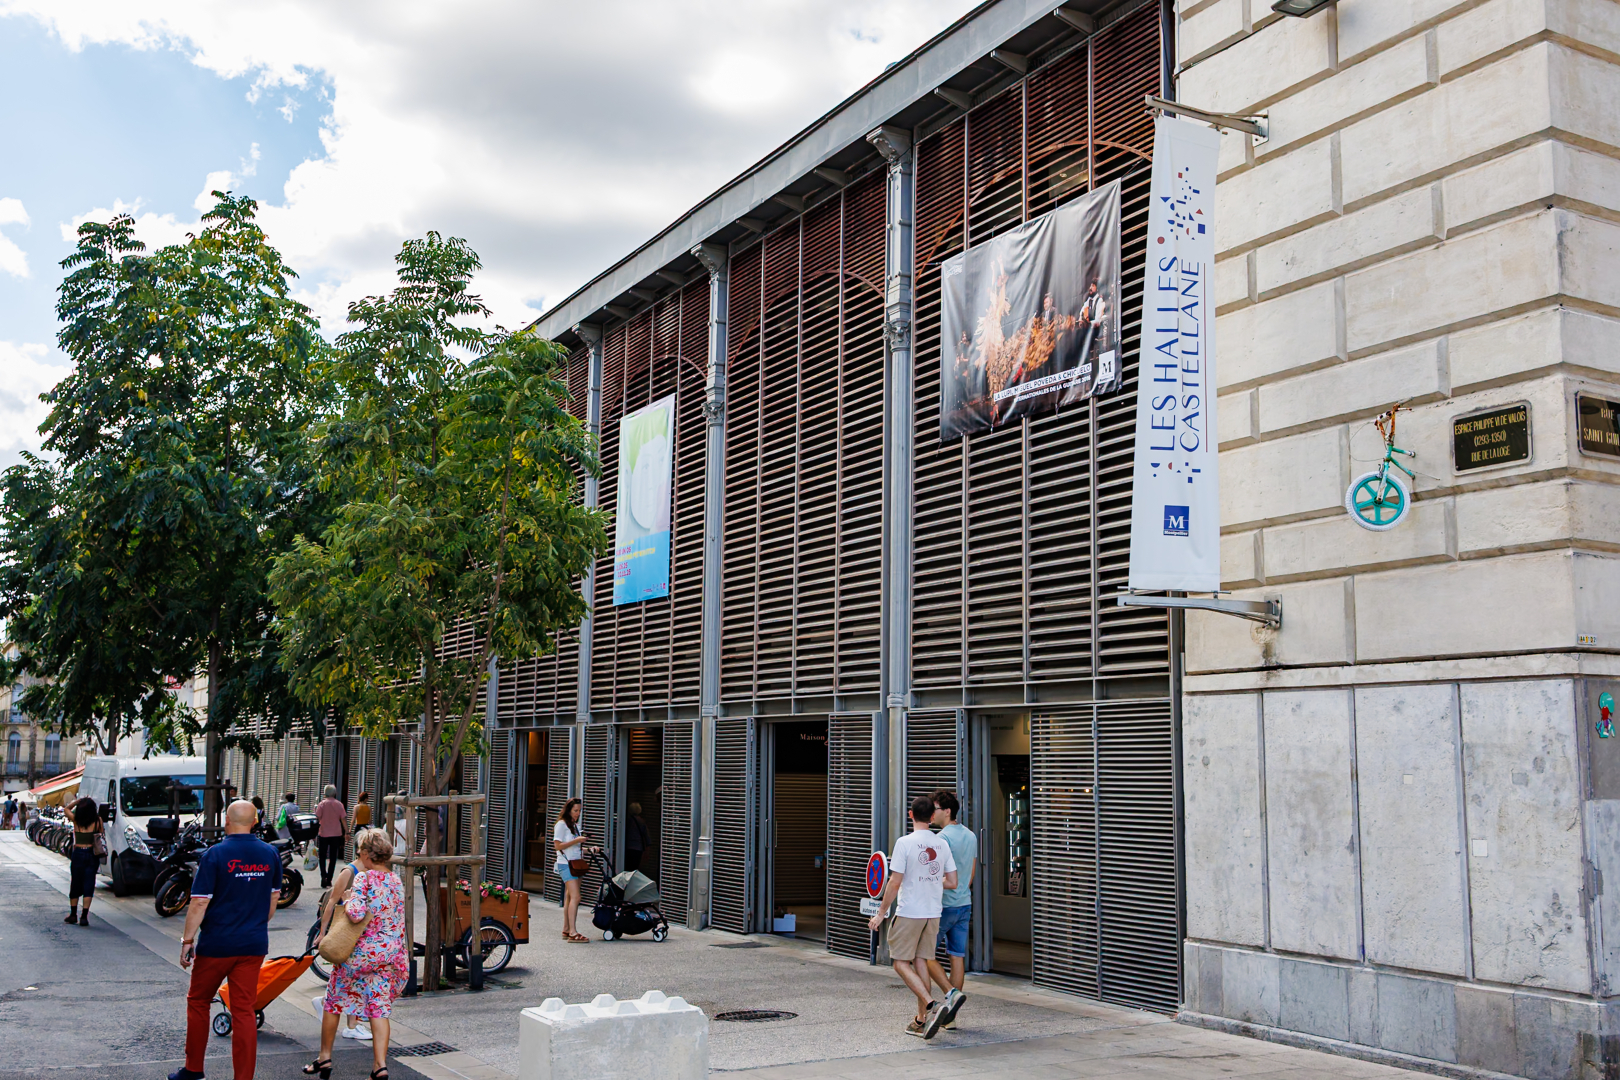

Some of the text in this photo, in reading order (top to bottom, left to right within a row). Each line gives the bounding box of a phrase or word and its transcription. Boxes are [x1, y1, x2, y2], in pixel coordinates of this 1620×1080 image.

[1150, 255, 1179, 451] LES HALLES
[1179, 258, 1200, 453] CASTELLANE
[1033, 375, 1057, 388] POVEDA
[1058, 373, 1062, 381] &
[1062, 365, 1091, 379] CHICUELO
[1102, 361, 1112, 375] M
[1601, 408, 1615, 420] RUE
[1455, 421, 1473, 435] ESPACE
[1473, 417, 1494, 431] PHILIPPE
[1500, 414, 1508, 426] DE
[1508, 411, 1526, 423] VALOIS
[1474, 429, 1507, 447] (1293-1350)
[1583, 427, 1603, 443] SAINT
[1471, 444, 1511, 462] RUE DE LA LOGE
[1168, 515, 1185, 529] M
[799, 733, 825, 741] Maison
[227, 859, 270, 873] France
